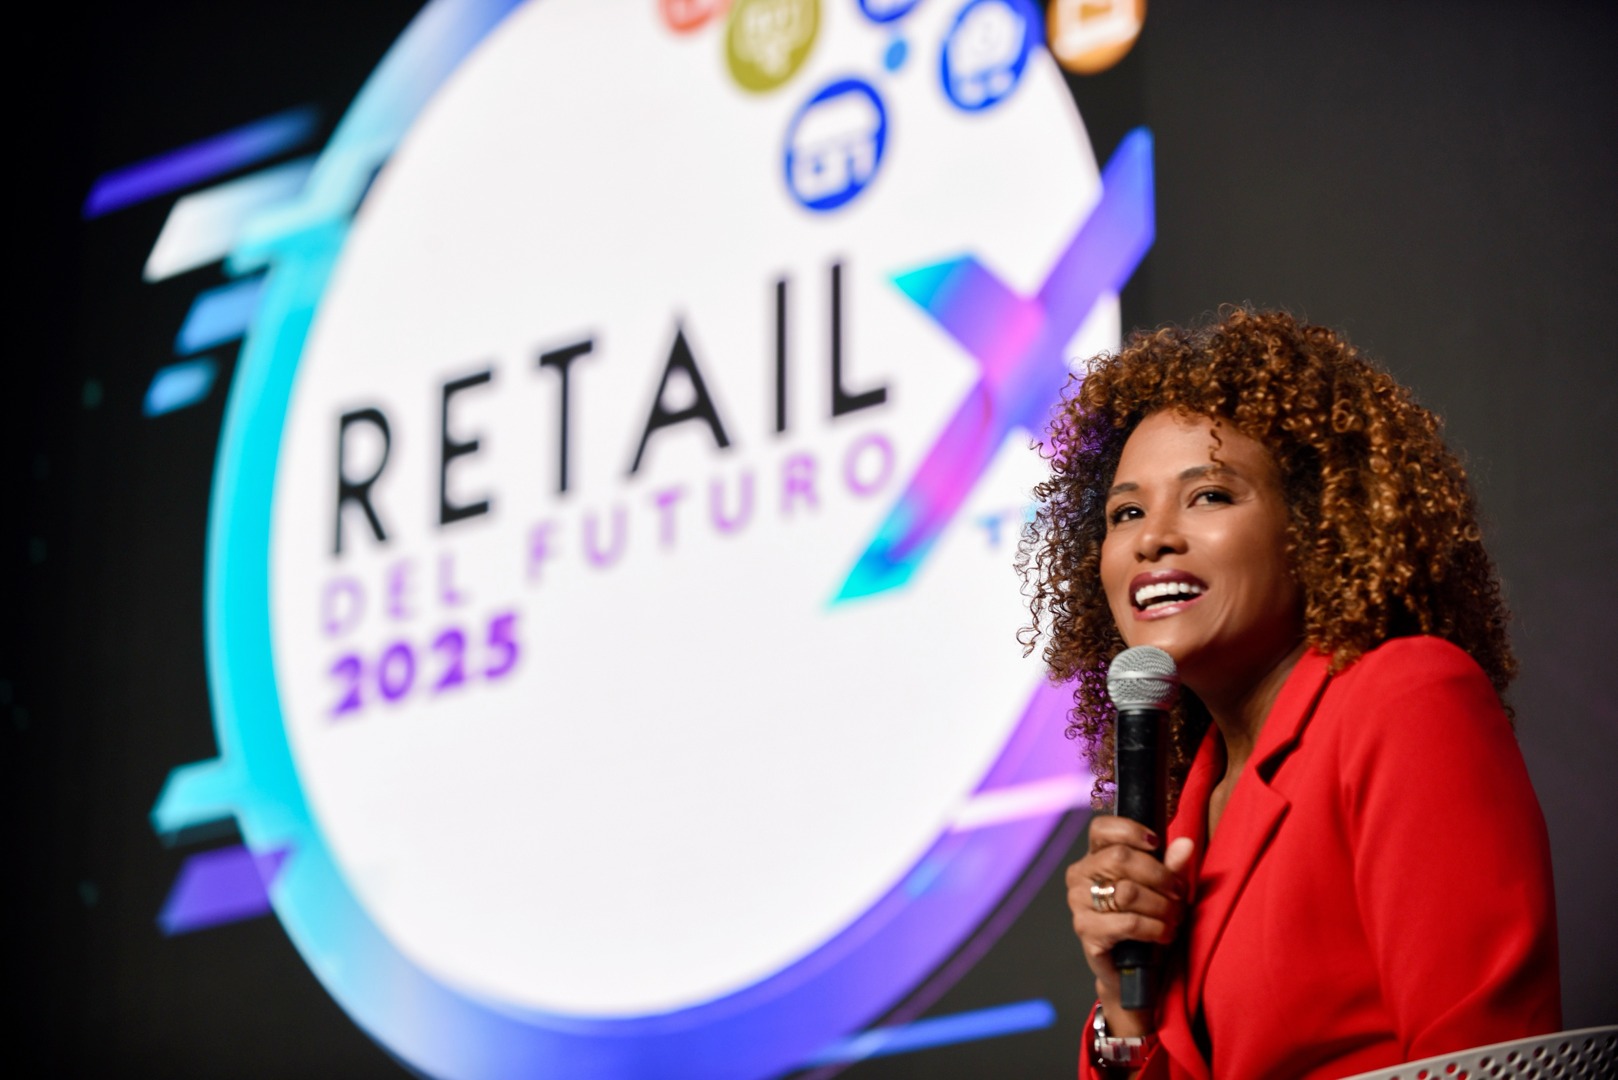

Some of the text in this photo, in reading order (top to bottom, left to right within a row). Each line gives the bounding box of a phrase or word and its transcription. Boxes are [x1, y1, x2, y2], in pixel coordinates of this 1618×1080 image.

[331, 258, 889, 558] RETAIL
[321, 552, 468, 638] DEL
[525, 431, 897, 585] FUTURO
[328, 609, 522, 721] 2025
